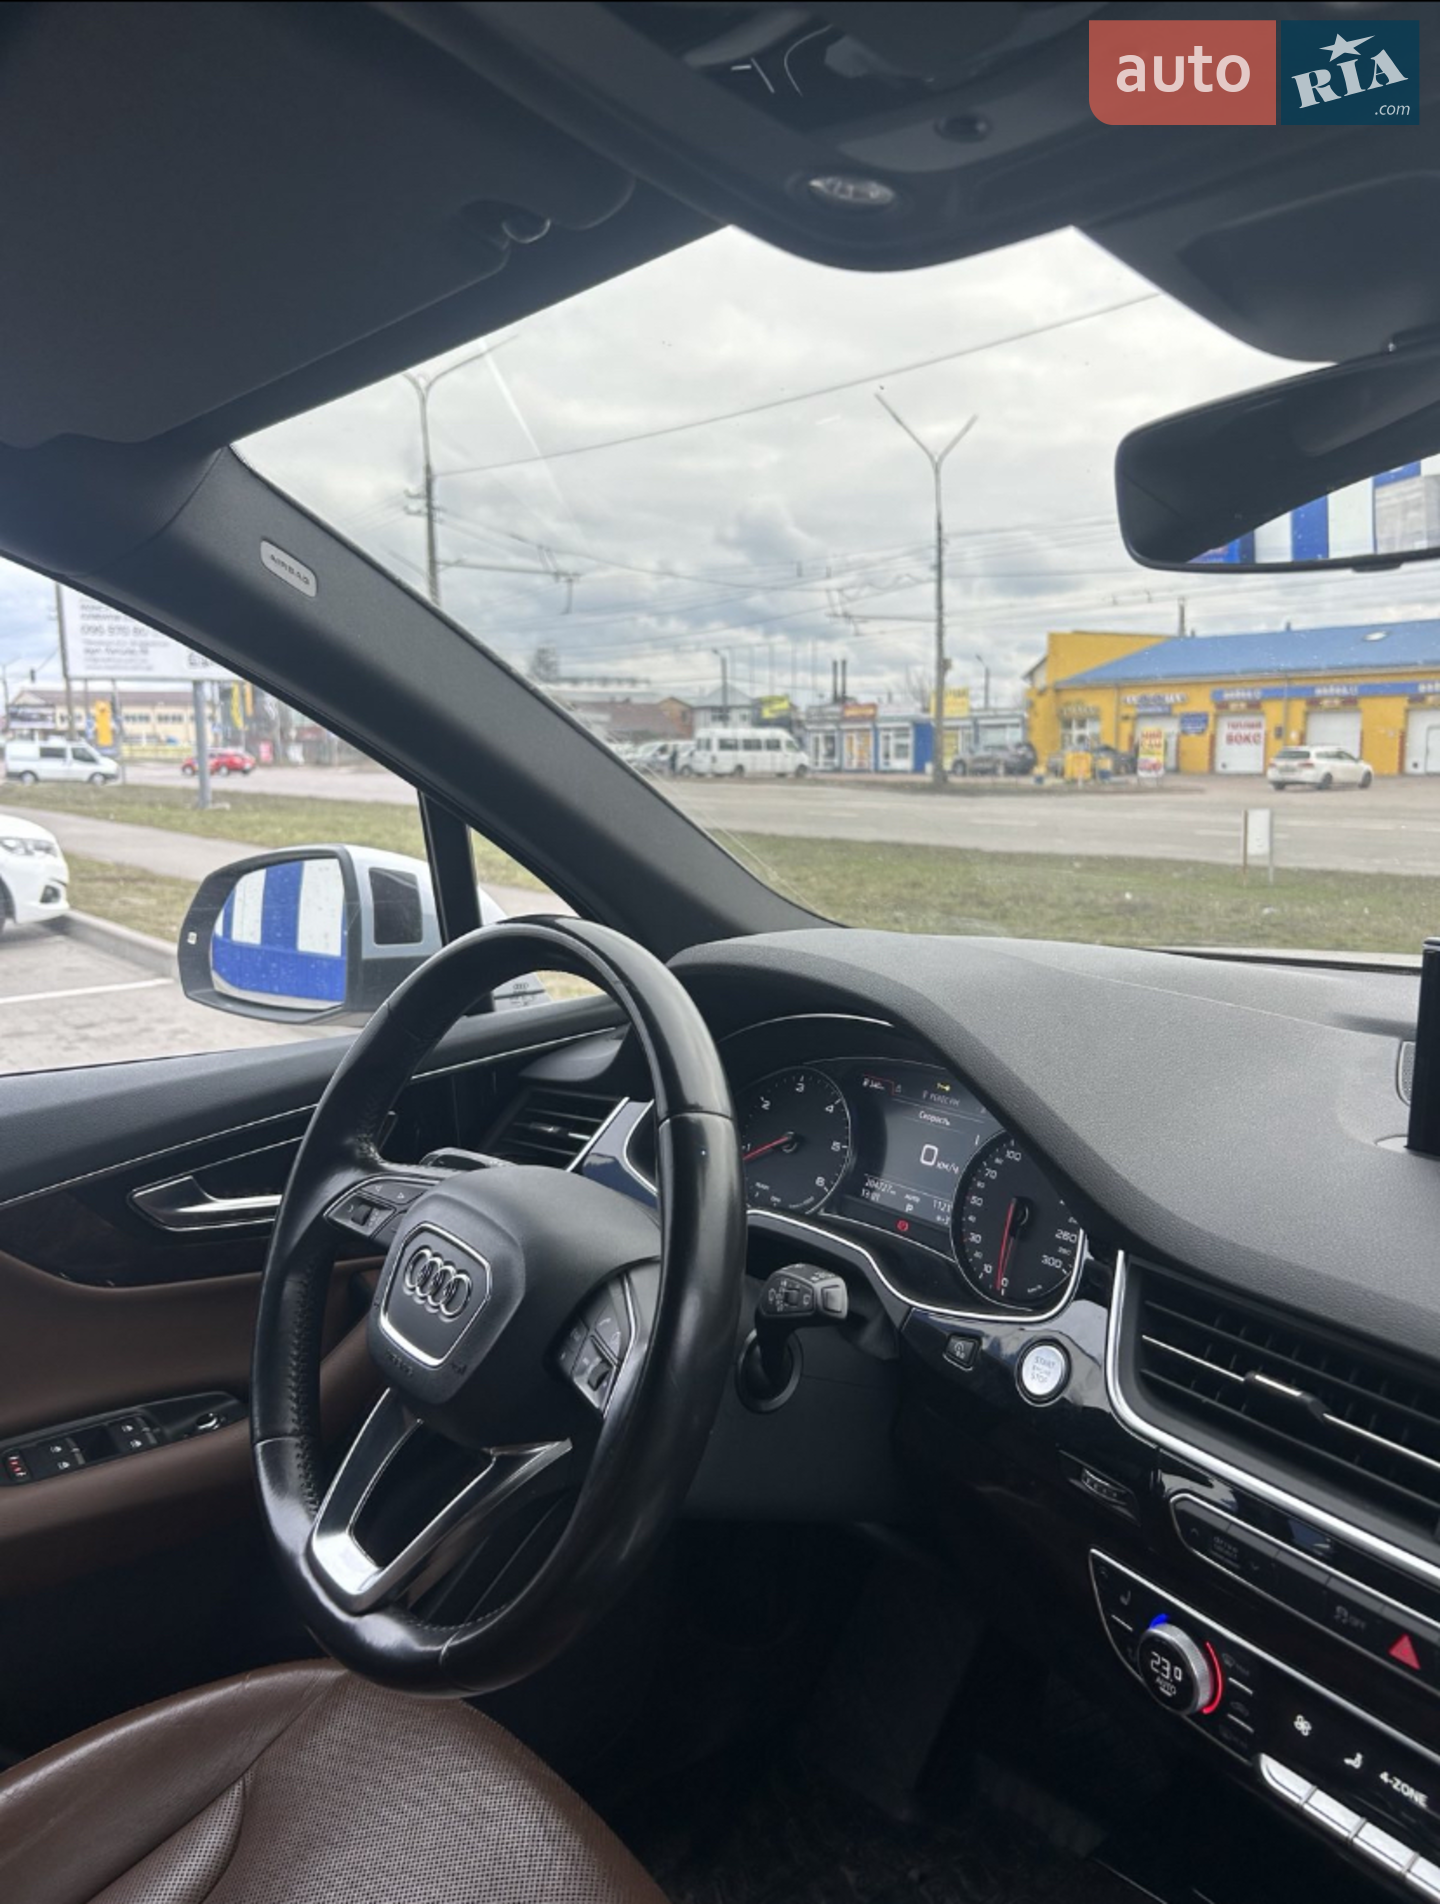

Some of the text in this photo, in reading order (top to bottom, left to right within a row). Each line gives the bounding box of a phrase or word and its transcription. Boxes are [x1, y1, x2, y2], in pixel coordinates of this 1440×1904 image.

[270, 554, 310, 585] AIRBAG
[1226, 732, 1262, 745] БОКС
[795, 1082, 805, 1093] 3
[761, 1100, 771, 1110] 2
[825, 1104, 835, 1113] 4
[918, 1110, 951, 1126] Скорость
[831, 1141, 841, 1152] 5
[920, 1144, 960, 1175] 0 км/ч
[1005, 1149, 1022, 1161] 100
[984, 1168, 997, 1179] 70
[905, 1203, 914, 1212] P
[970, 1196, 984, 1207] 50
[968, 1232, 982, 1244] 30
[1055, 1229, 1077, 1244] 260
[1041, 1254, 1063, 1269] 300
[983, 1263, 993, 1274] 10
[1001, 1277, 1009, 1287] 0
[1156, 1676, 1176, 1695] AUTO
[1379, 1771, 1428, 1808] 4-ZONE
